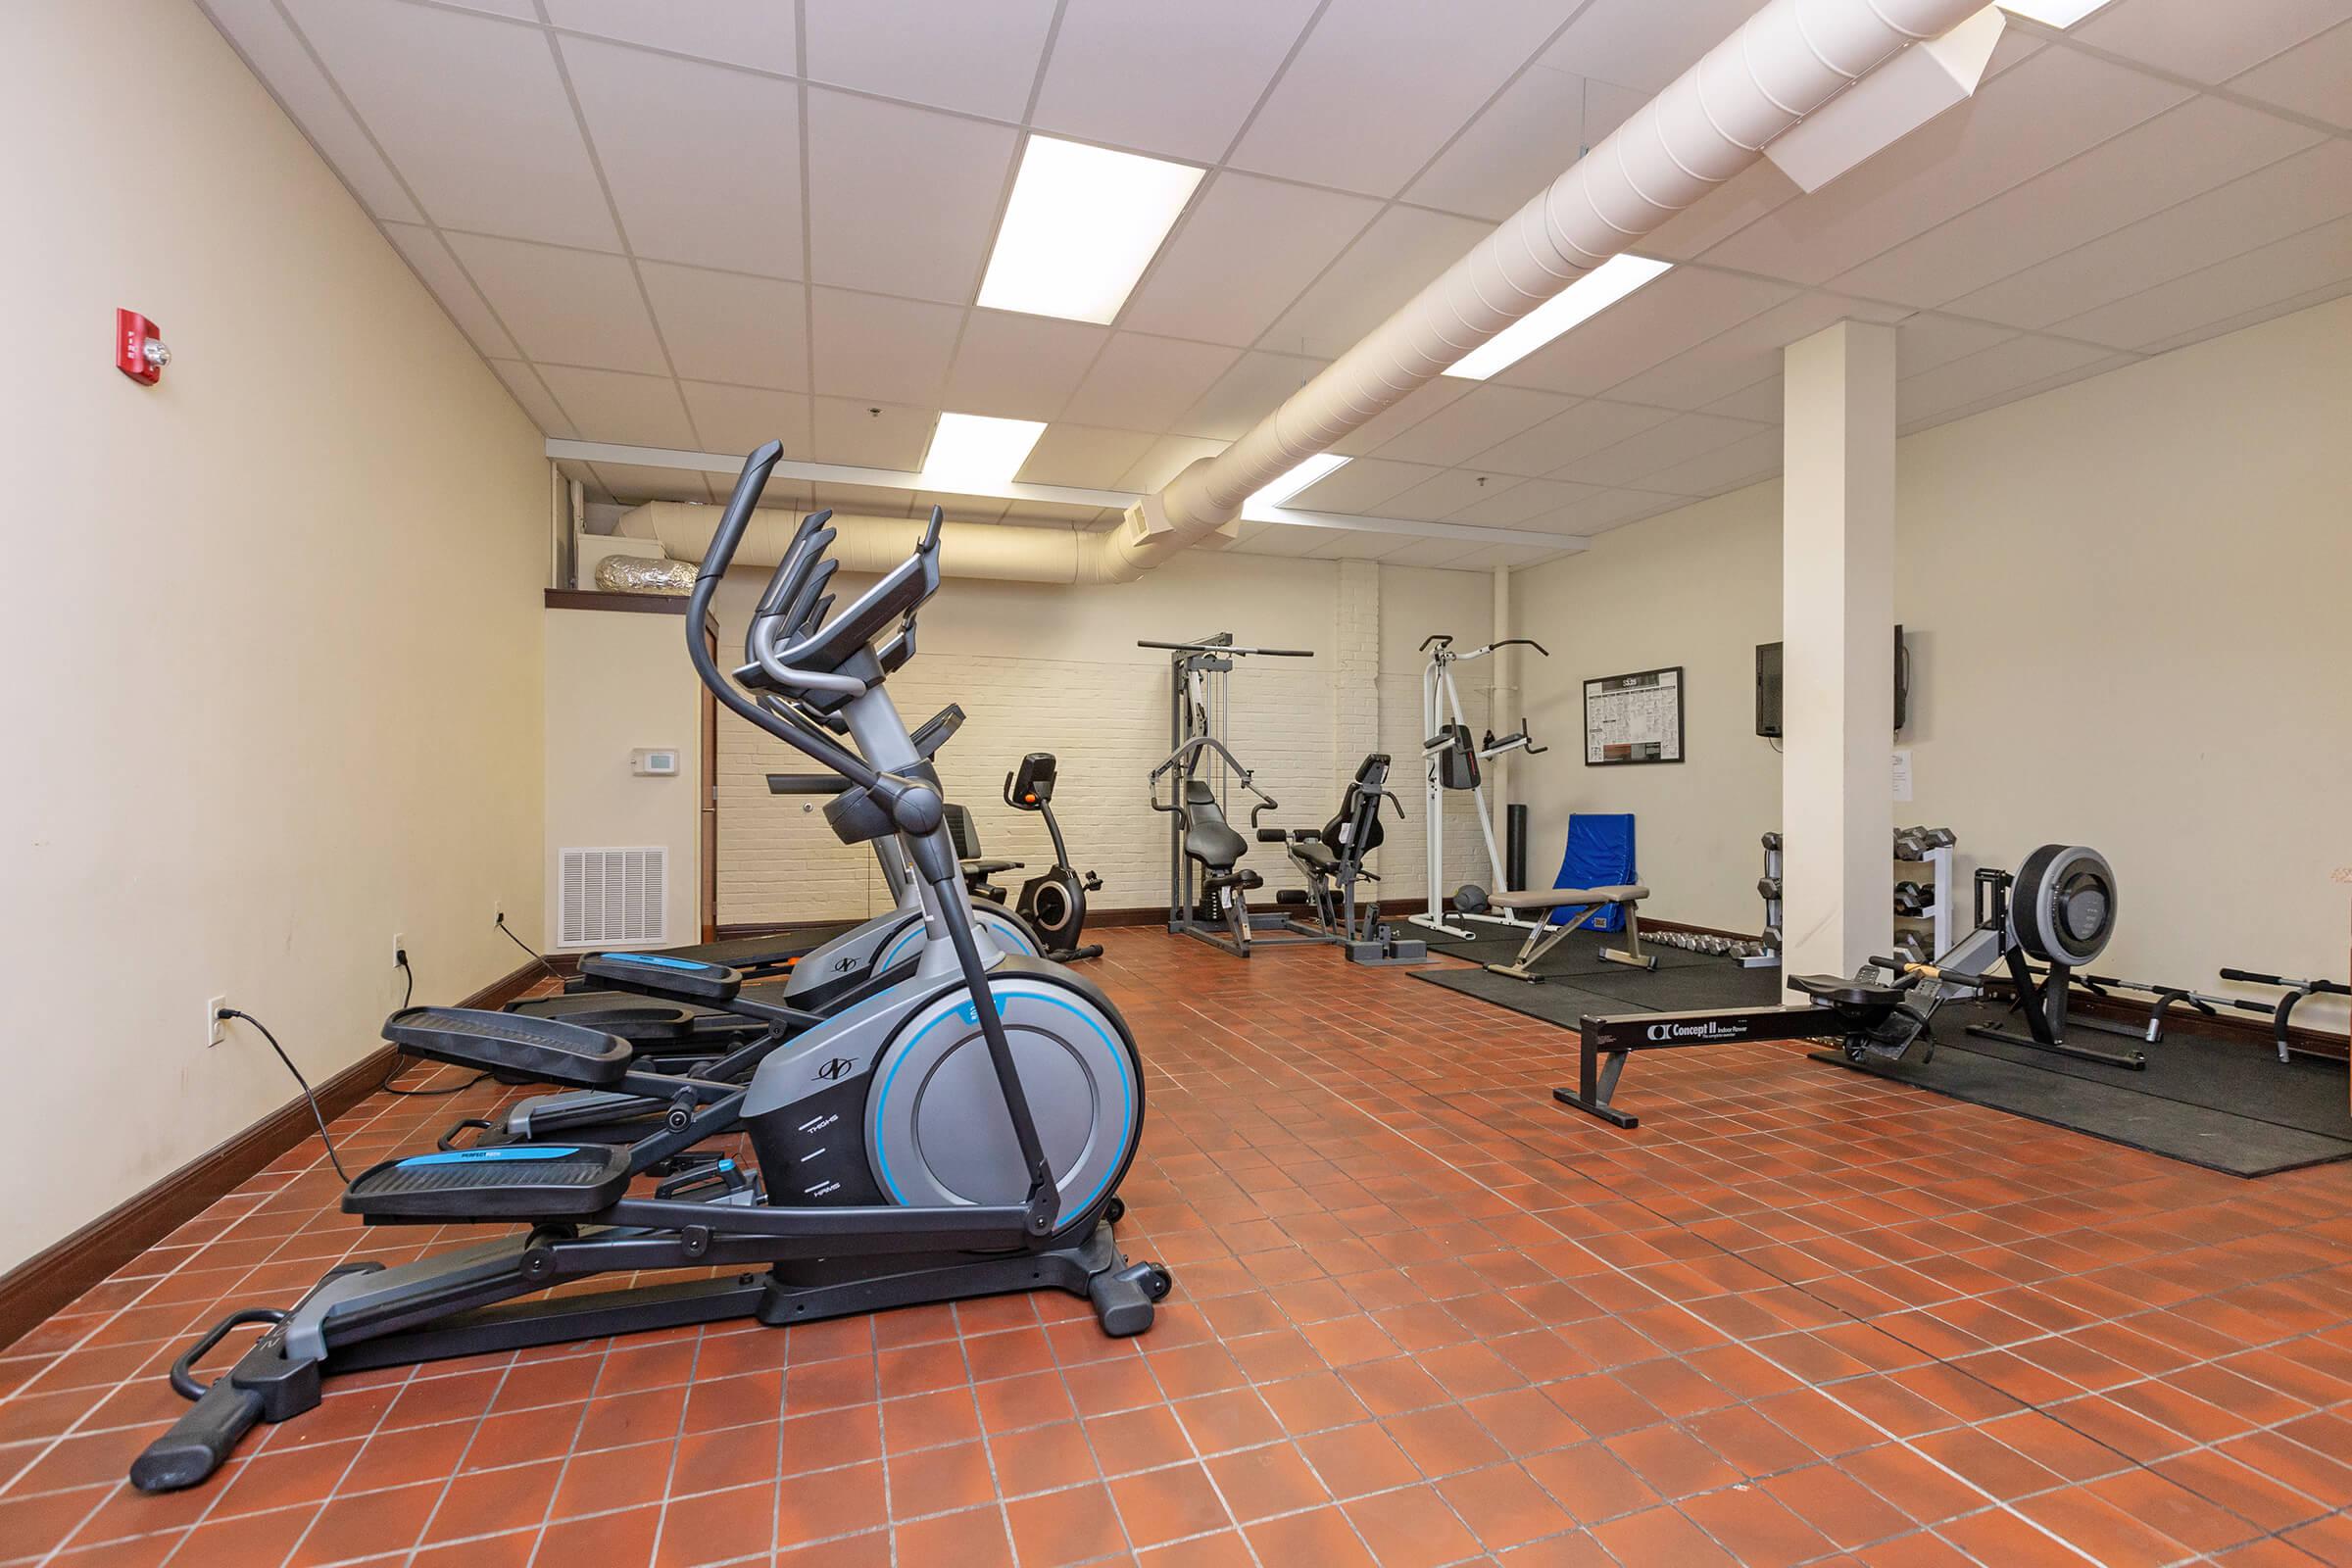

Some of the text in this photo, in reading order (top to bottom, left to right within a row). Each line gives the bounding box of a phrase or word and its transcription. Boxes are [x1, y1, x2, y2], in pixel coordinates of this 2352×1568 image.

[1673, 1024, 1708, 1037] Concept
[807, 1114, 839, 1133] THIGHS
[813, 1182, 841, 1197] HAMS
